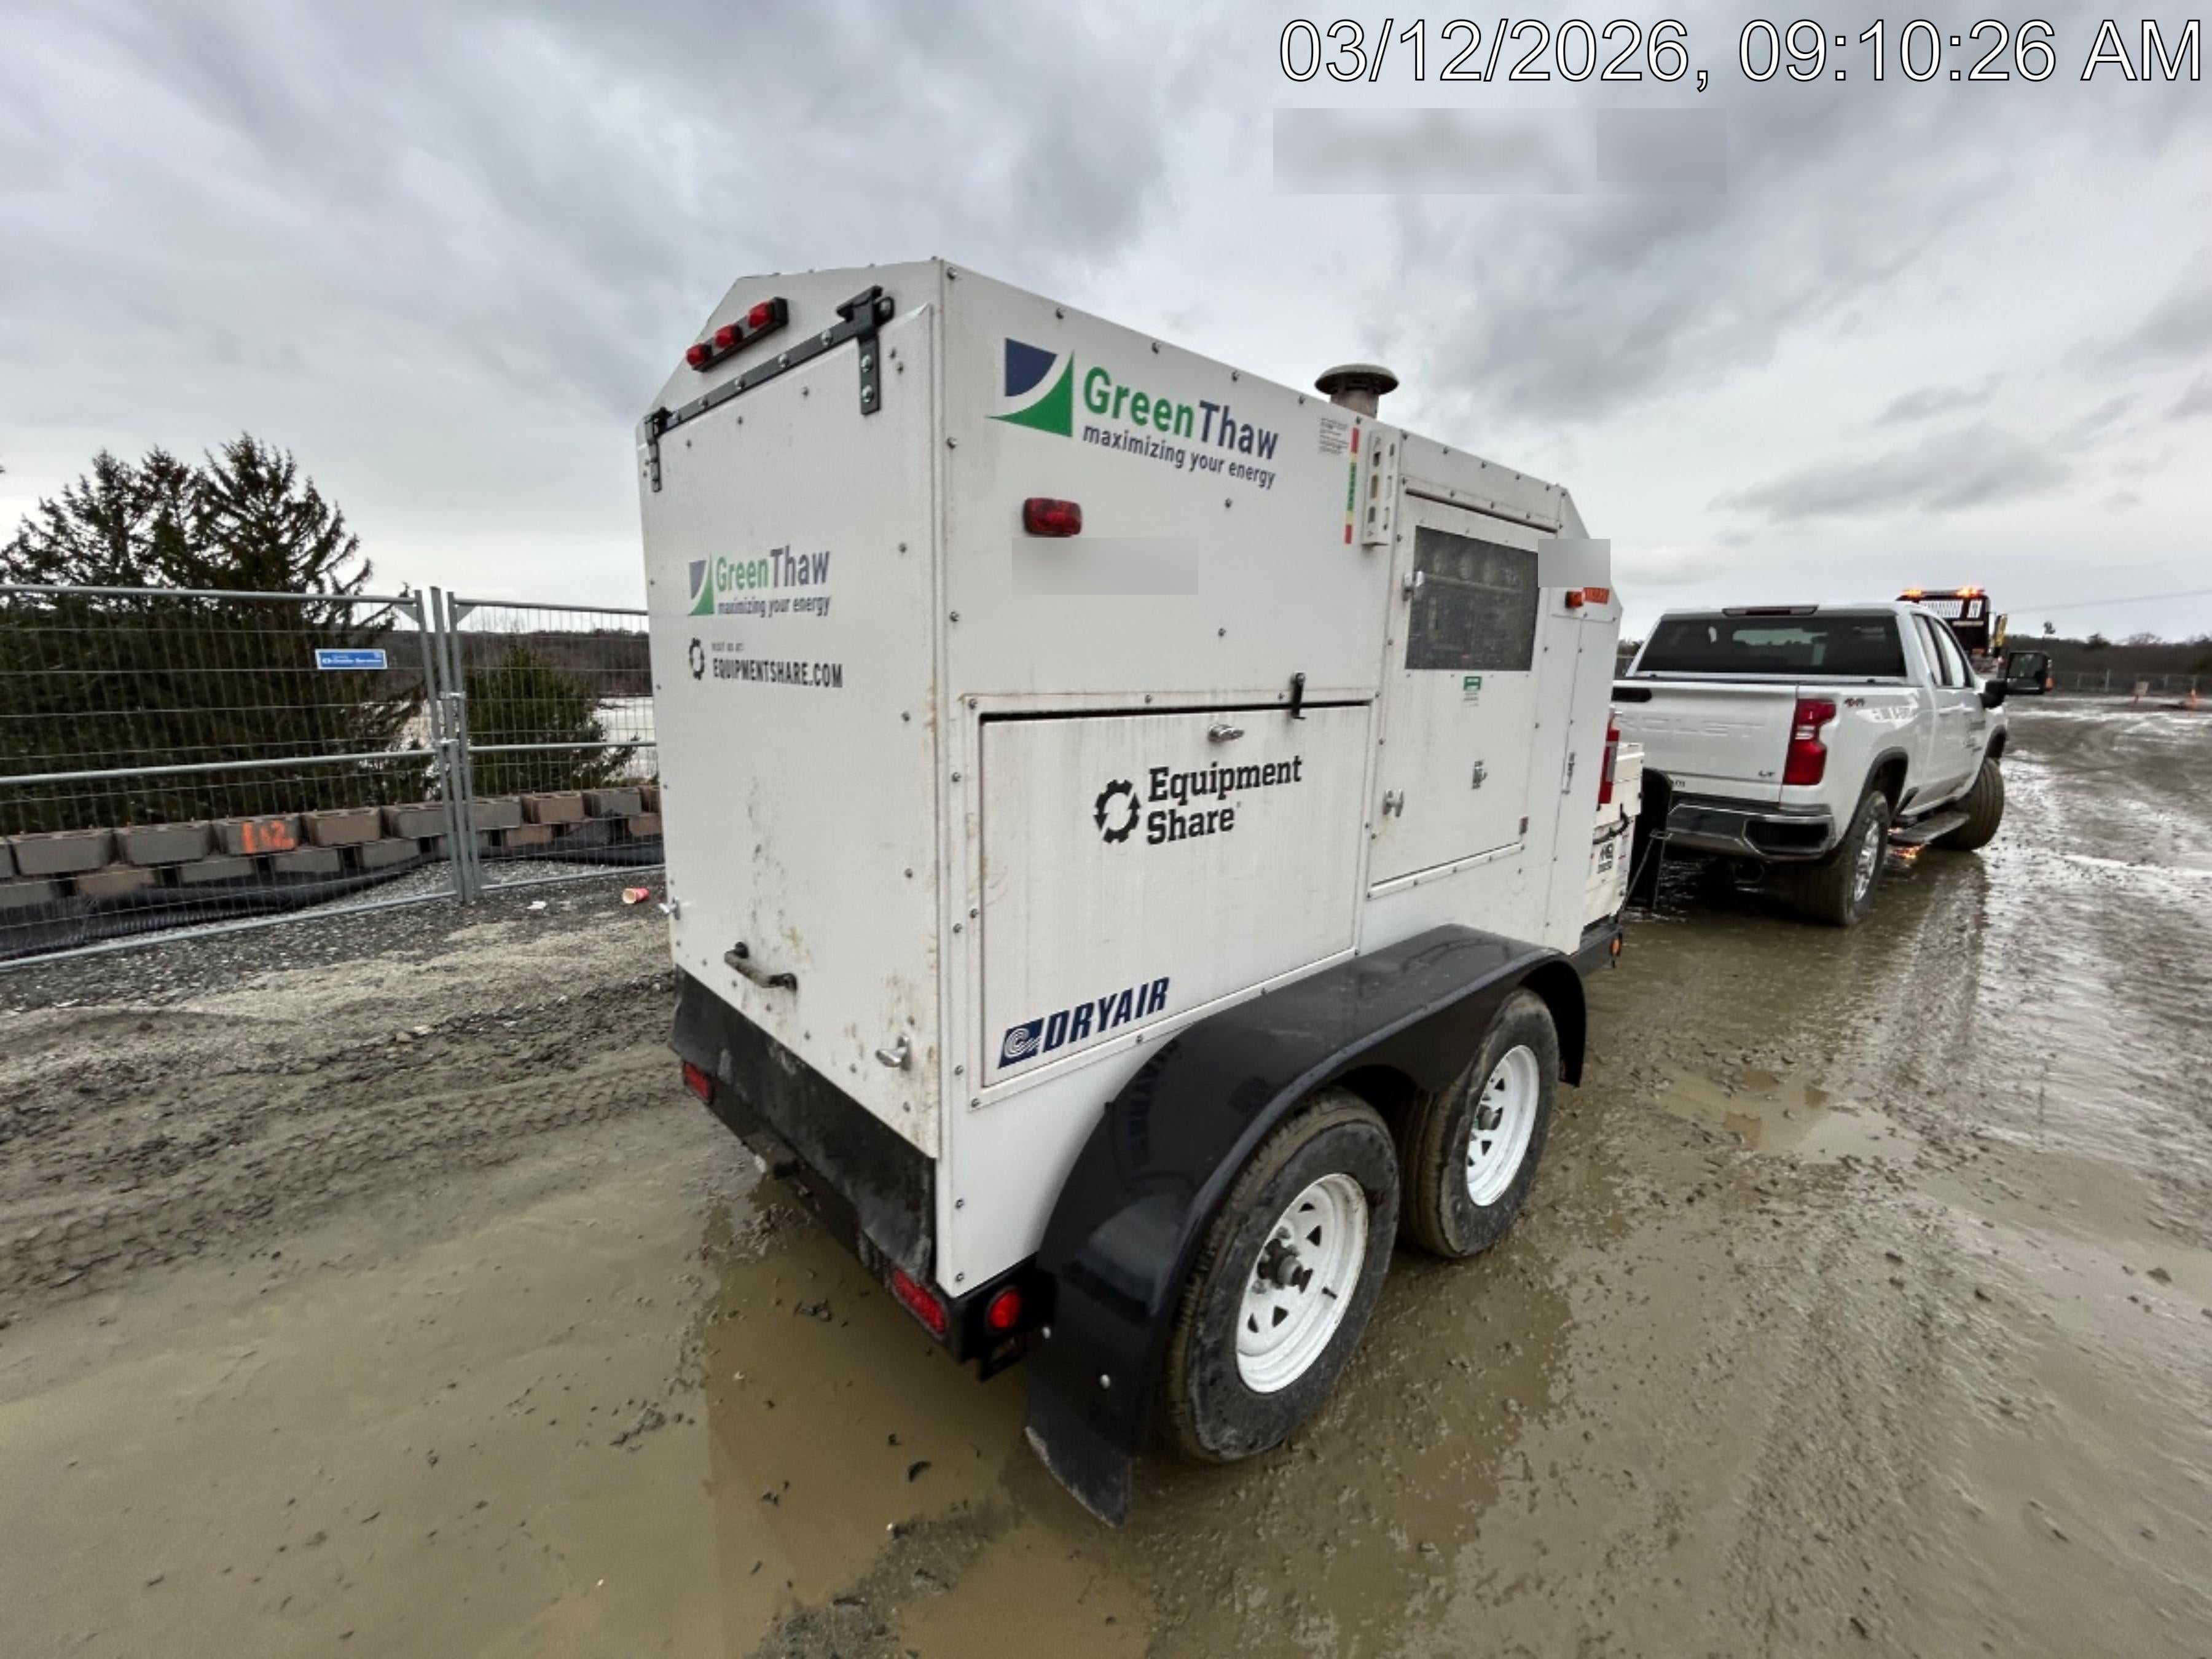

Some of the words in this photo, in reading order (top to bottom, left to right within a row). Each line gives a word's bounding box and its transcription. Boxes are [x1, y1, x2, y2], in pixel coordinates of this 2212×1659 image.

[1083, 366, 1279, 461] GreenThaw
[1083, 425, 1186, 468] maximizing
[1189, 452, 1225, 471] your
[1228, 461, 1277, 490] energy
[716, 544, 831, 592] GreenThaw
[718, 596, 766, 618] maximizing
[769, 598, 791, 618] your
[793, 595, 831, 617] energy
[713, 657, 843, 688] EQUIPMENTSHARE.COM
[1147, 755, 1303, 806] Equipment
[1147, 807, 1234, 845] Share
[1041, 976, 1170, 1053] DRYAIR
